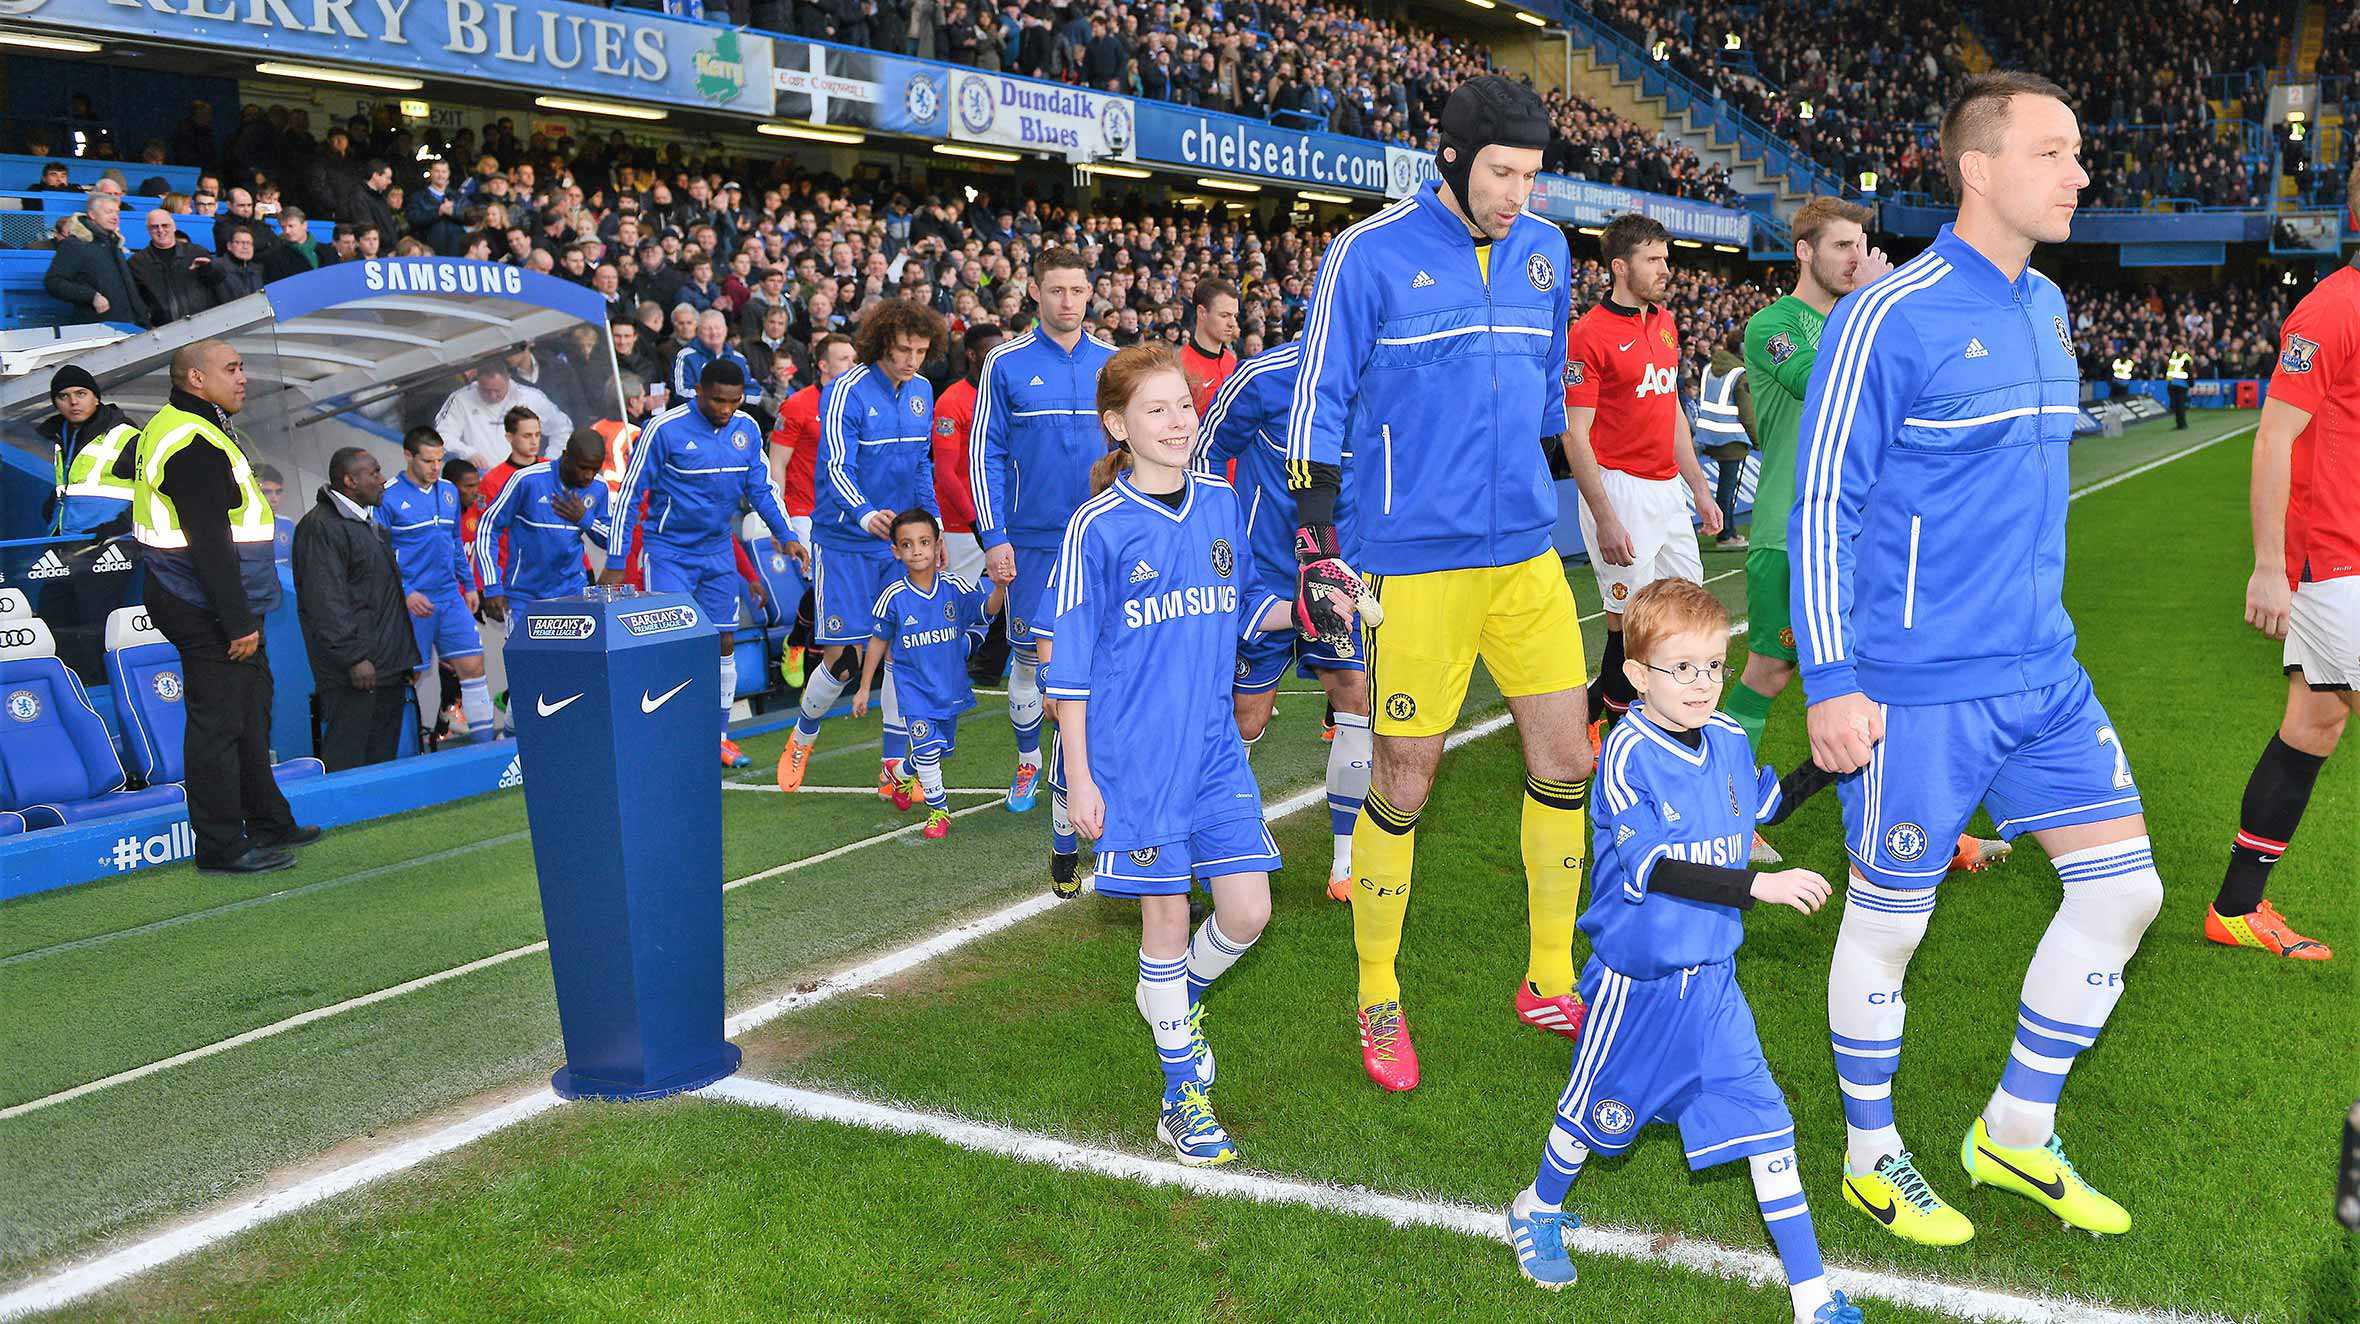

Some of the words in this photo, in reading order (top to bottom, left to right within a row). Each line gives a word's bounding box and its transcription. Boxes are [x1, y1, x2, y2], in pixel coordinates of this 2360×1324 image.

[443, 0, 668, 82] BLUES
[1000, 80, 1096, 119] Dundalk
[1020, 116, 1079, 148] Blues
[1181, 118, 1385, 188] chelseafc.com
[364, 260, 522, 294] SAMSUNG
[28, 565, 70, 580] adidas
[92, 559, 133, 573] adidas
[1129, 570, 1159, 584] adidas
[630, 609, 679, 627] BARCLAYS
[1124, 585, 1237, 629] SAMSUNG
[535, 619, 579, 630] BARCLAYS
[1360, 878, 1407, 897] CFC
